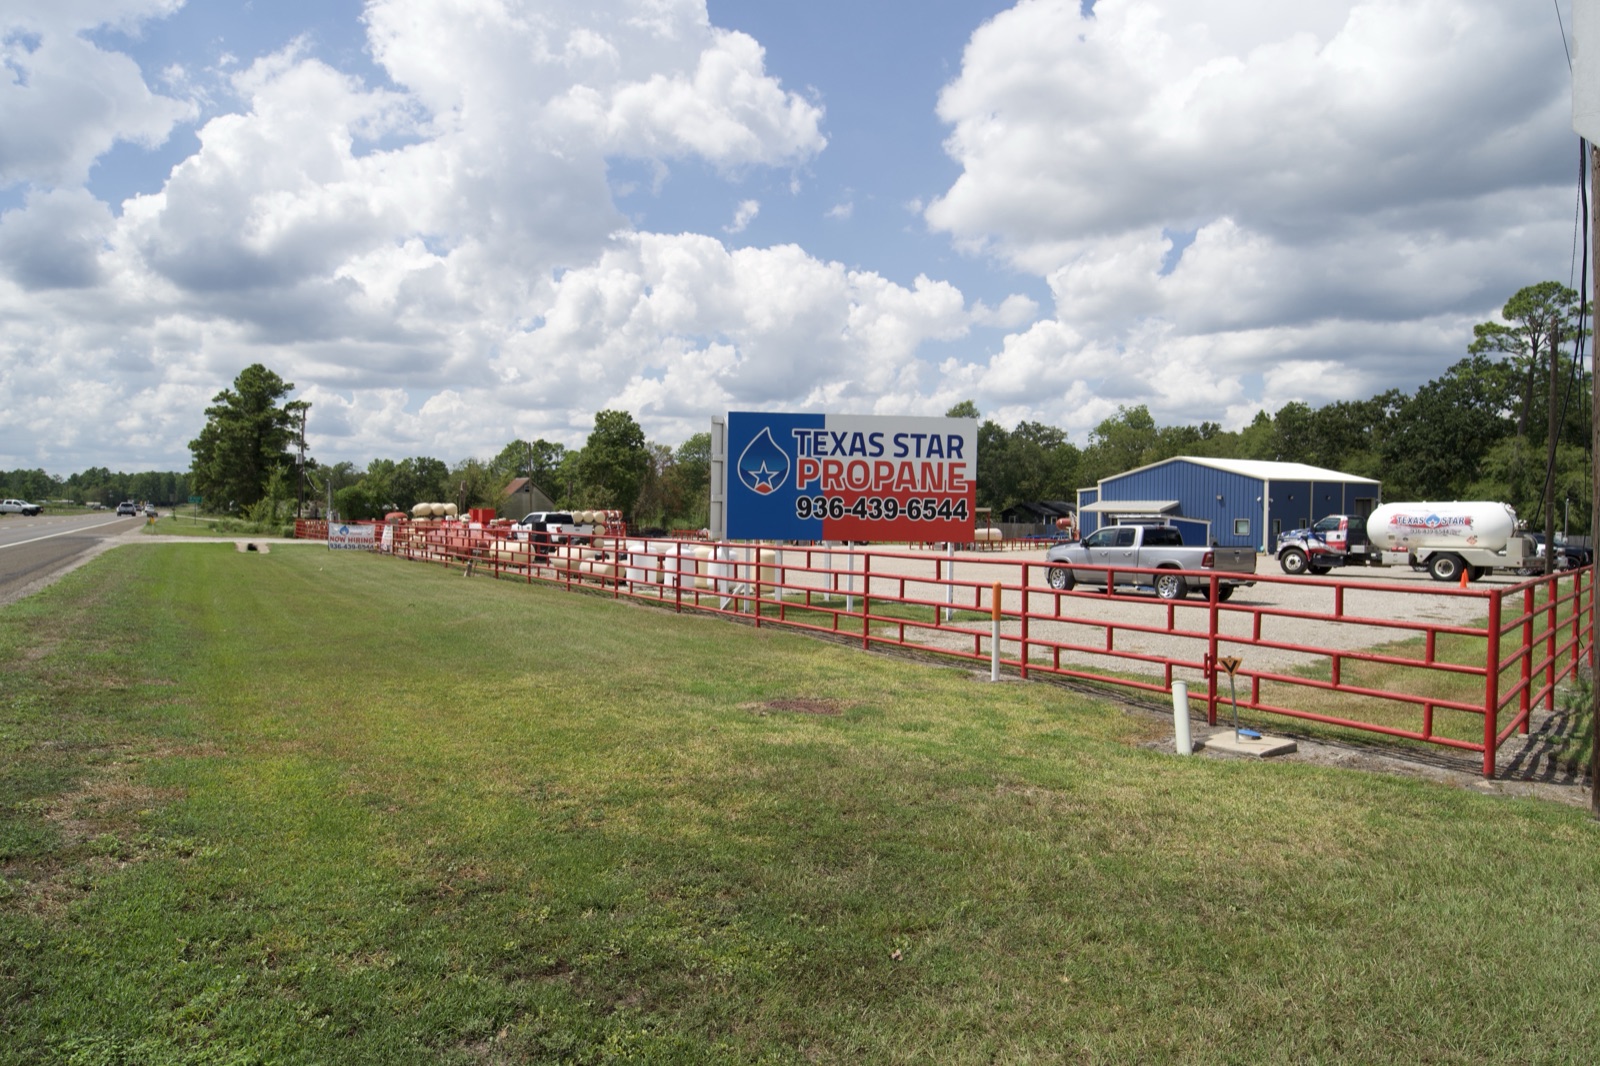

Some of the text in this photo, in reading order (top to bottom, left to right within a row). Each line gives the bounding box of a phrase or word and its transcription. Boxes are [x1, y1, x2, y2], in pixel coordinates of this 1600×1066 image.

[793, 429, 964, 459] TEXAS STAR
[796, 458, 968, 493] PROPANE
[796, 495, 968, 522] 936-439-6544
[1397, 517, 1464, 525] TEXAS STAR
[348, 536, 374, 544] HIRING
